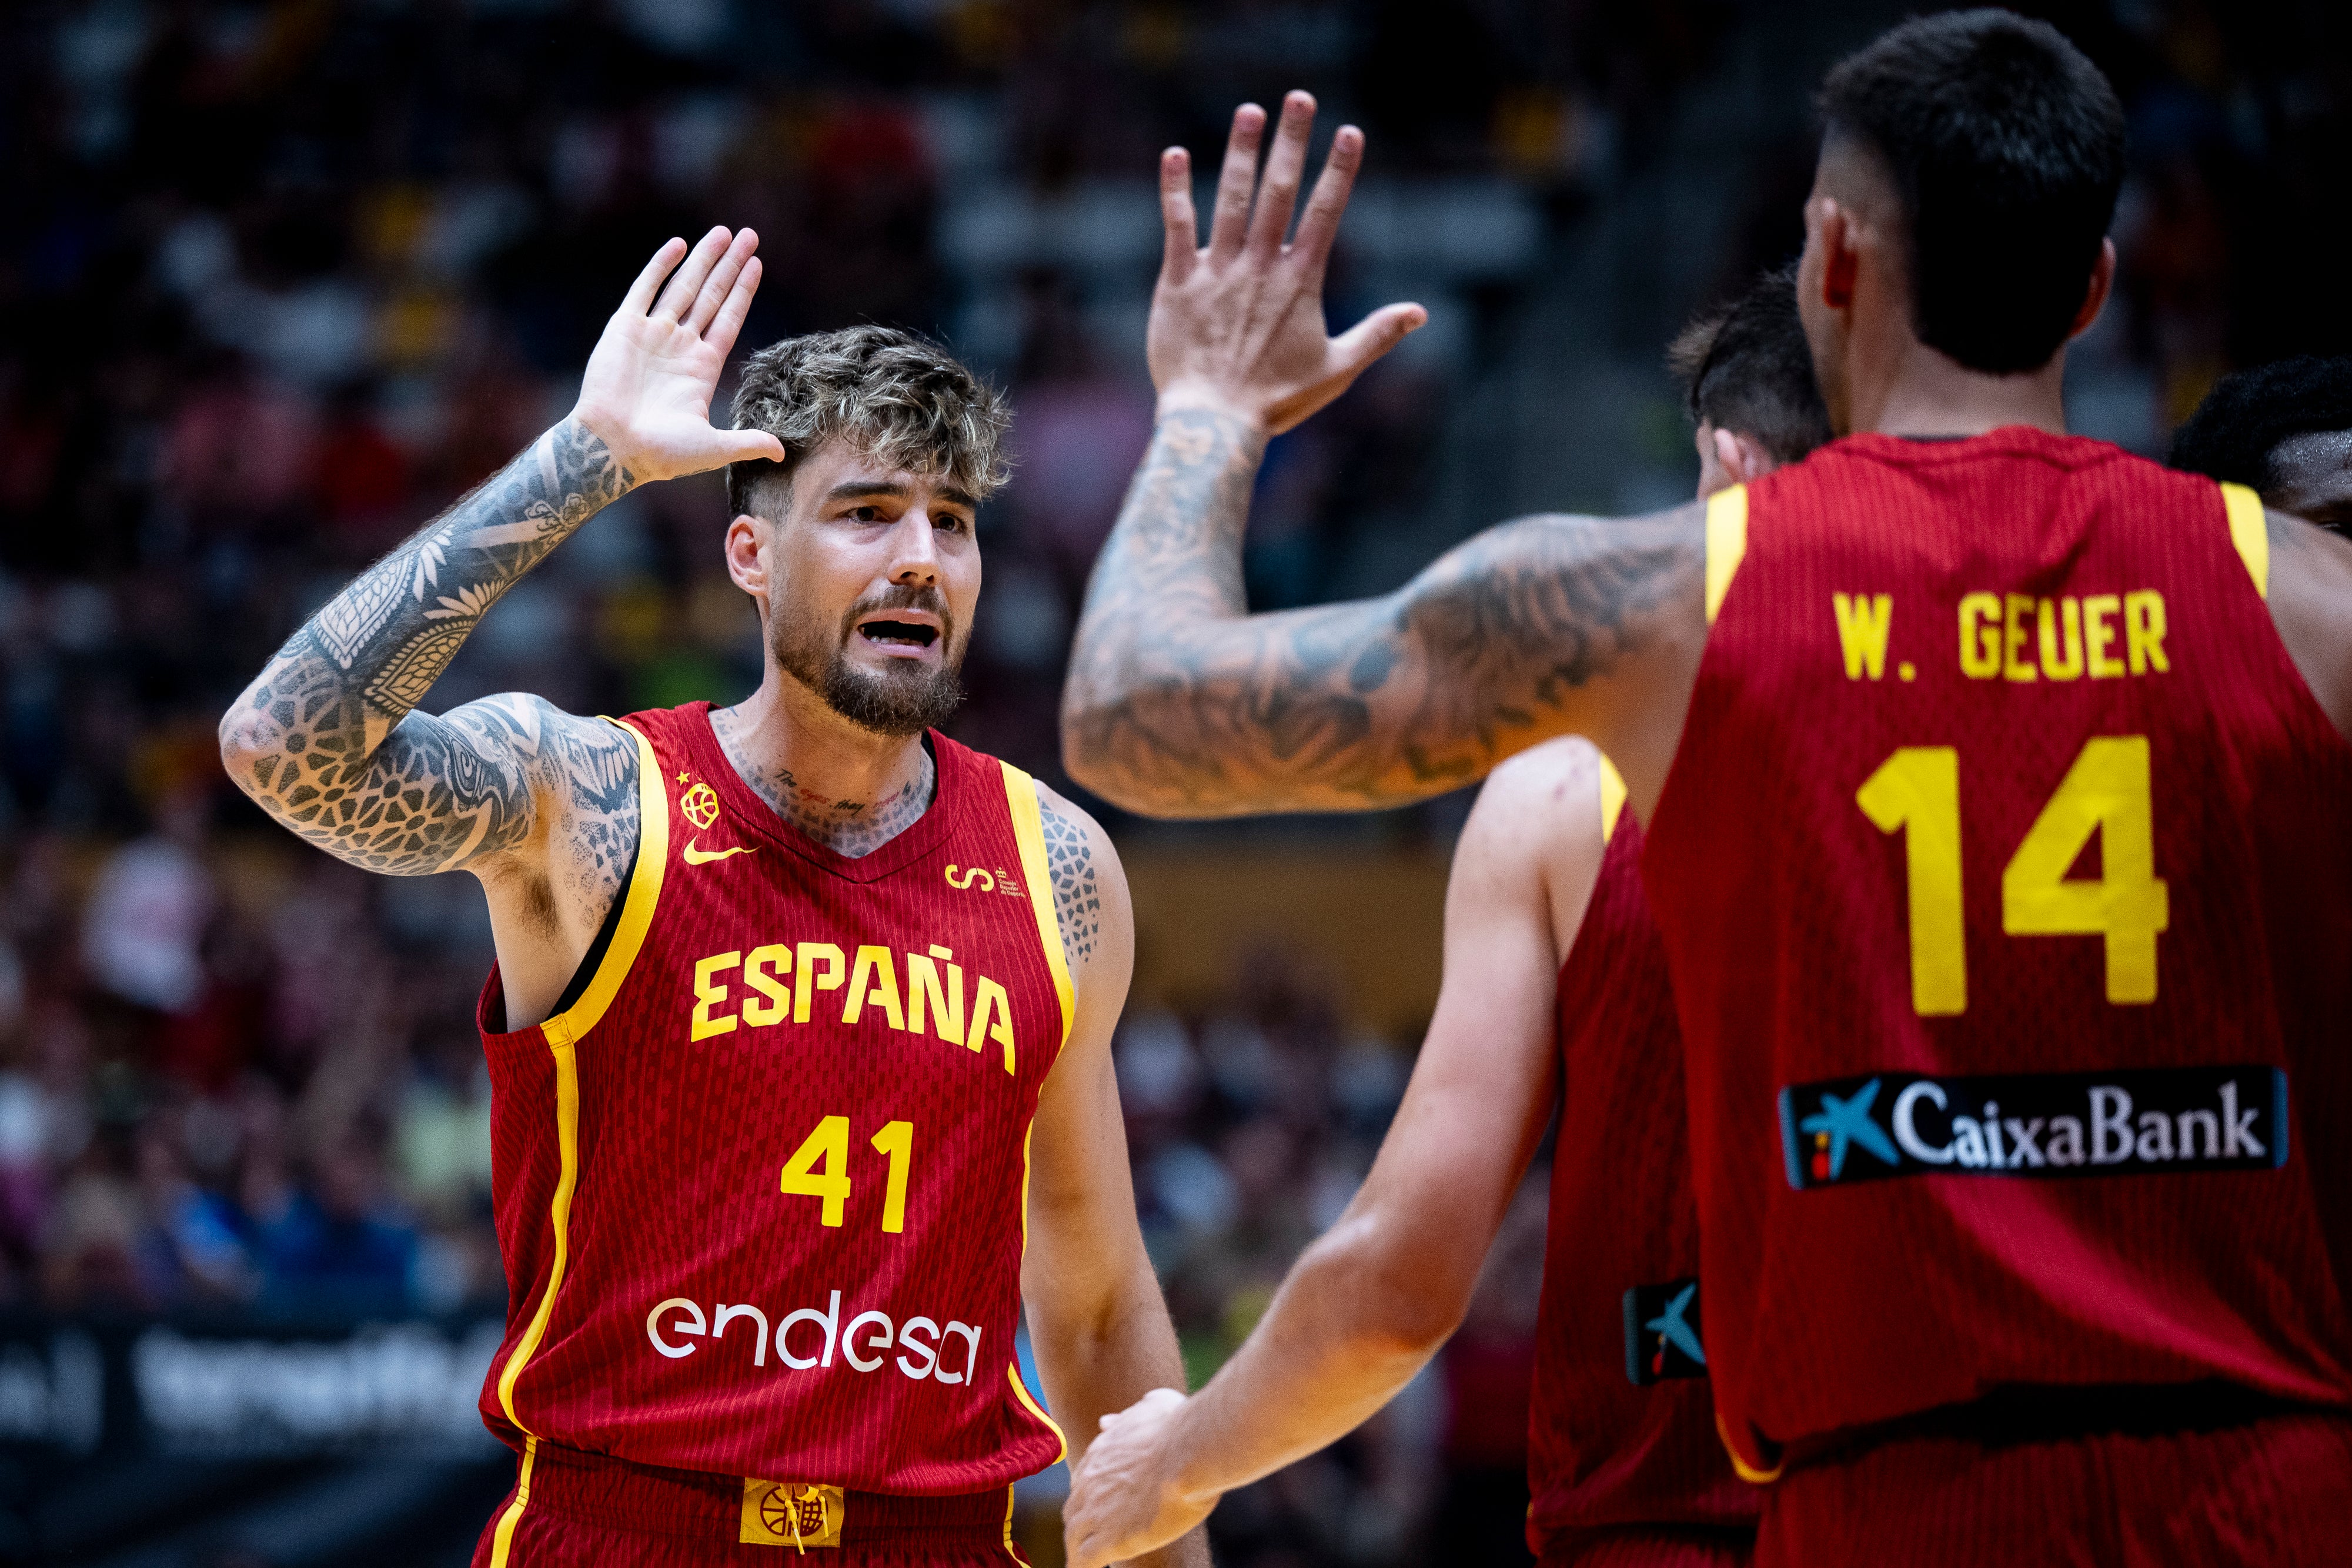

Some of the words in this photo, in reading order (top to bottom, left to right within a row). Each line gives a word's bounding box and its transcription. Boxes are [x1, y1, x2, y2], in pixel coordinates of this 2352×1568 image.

[1832, 591, 1916, 683] W.
[1957, 589, 2170, 683] GEUER
[1855, 734, 2170, 1017] 14
[691, 942, 1015, 1076] ESPAÑA
[780, 1115, 913, 1233] 41
[1892, 1079, 2267, 1169] CaixaBank
[647, 1290, 982, 1386] endesa
